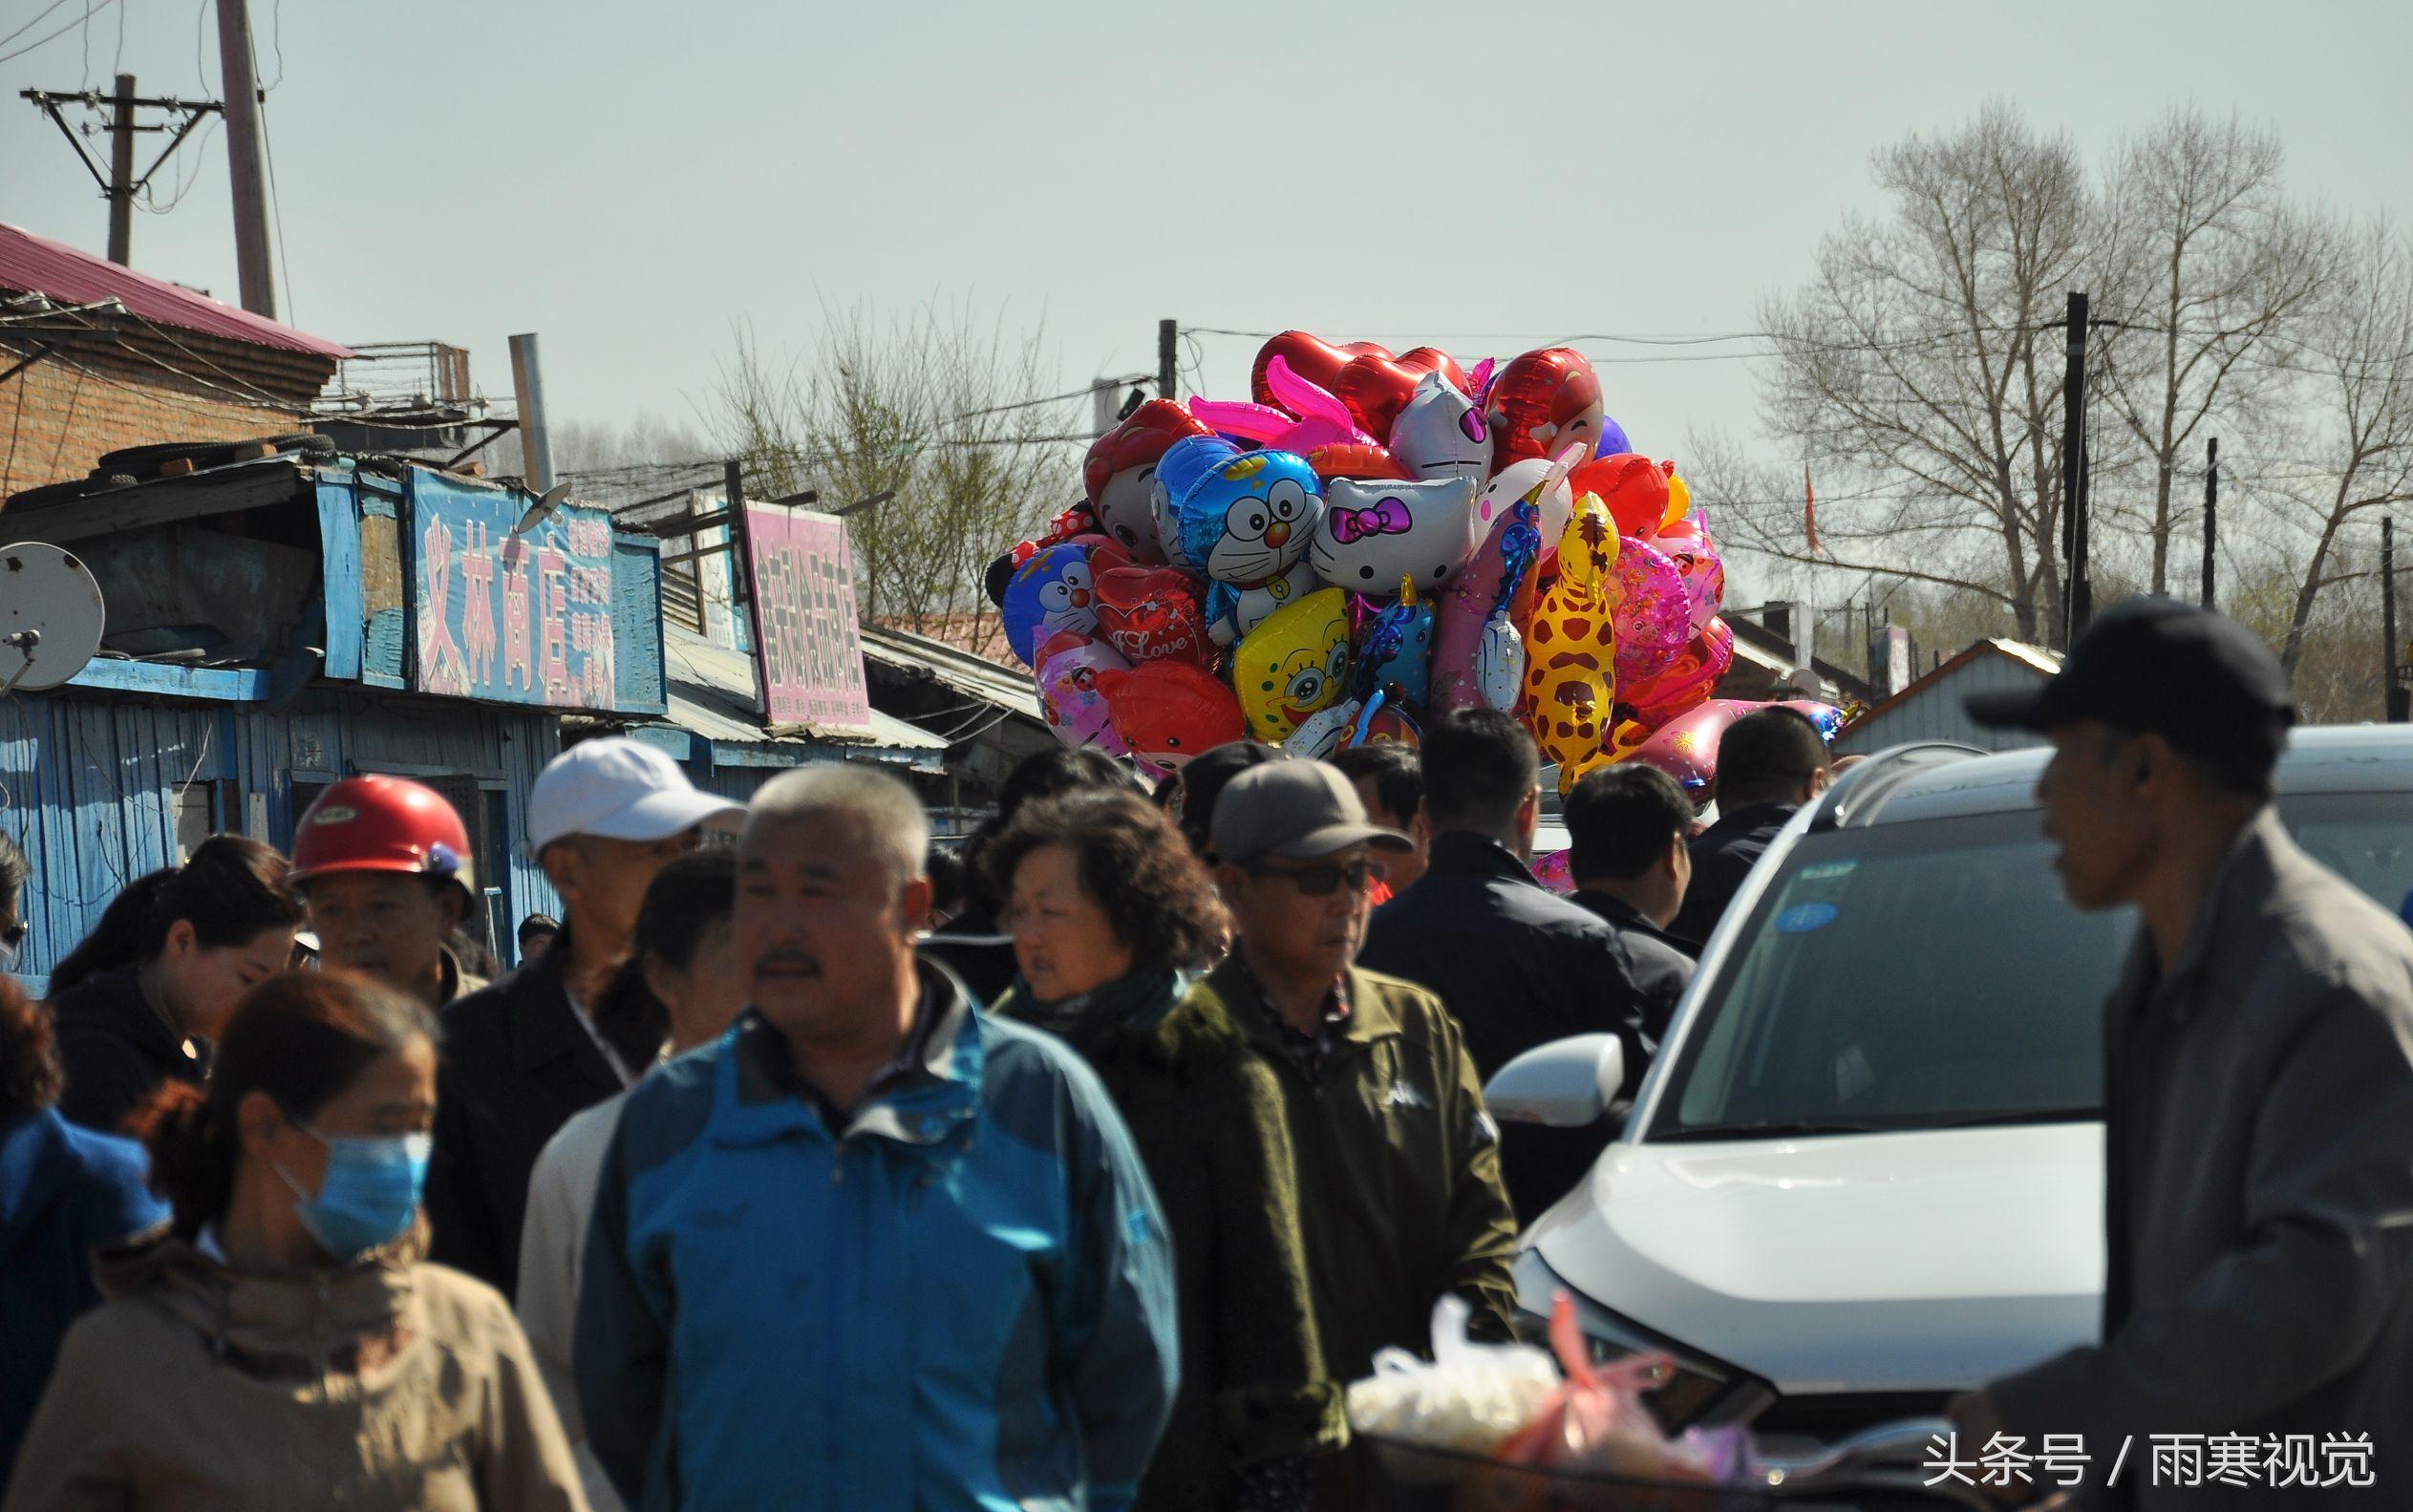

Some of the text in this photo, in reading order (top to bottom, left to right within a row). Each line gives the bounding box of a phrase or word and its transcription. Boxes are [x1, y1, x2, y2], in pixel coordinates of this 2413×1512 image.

[423, 512, 568, 694] 义林商店
[1124, 629, 1187, 659] Love
